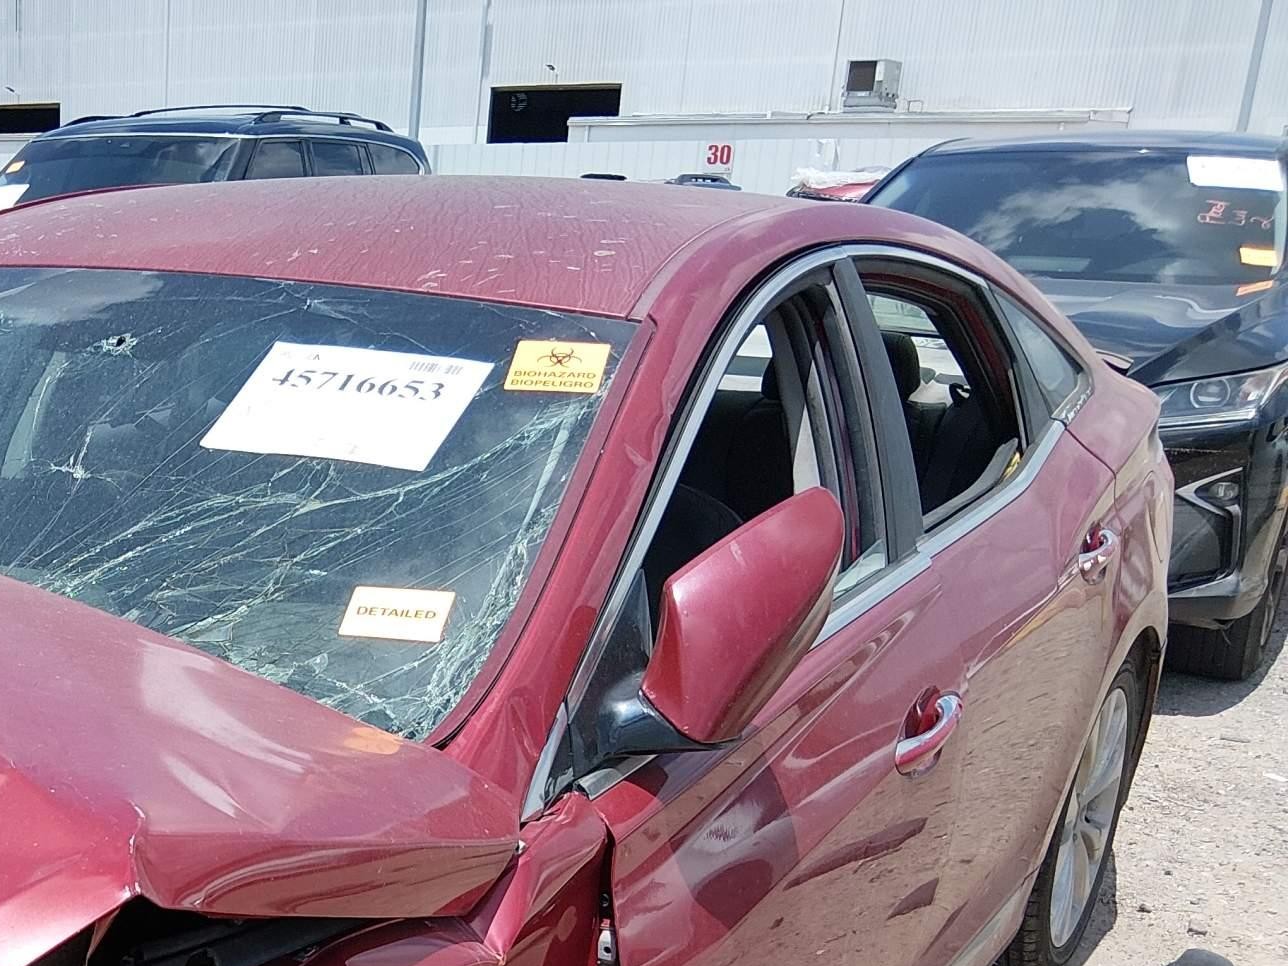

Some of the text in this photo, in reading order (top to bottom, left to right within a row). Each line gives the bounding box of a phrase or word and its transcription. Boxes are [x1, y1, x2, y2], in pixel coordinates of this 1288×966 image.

[707, 144, 732, 165] 30
[513, 369, 597, 380] BIOHAZARD
[272, 368, 445, 400] 45716653
[510, 378, 595, 389] BIOPELIGRO
[356, 606, 437, 620] DETAILED
